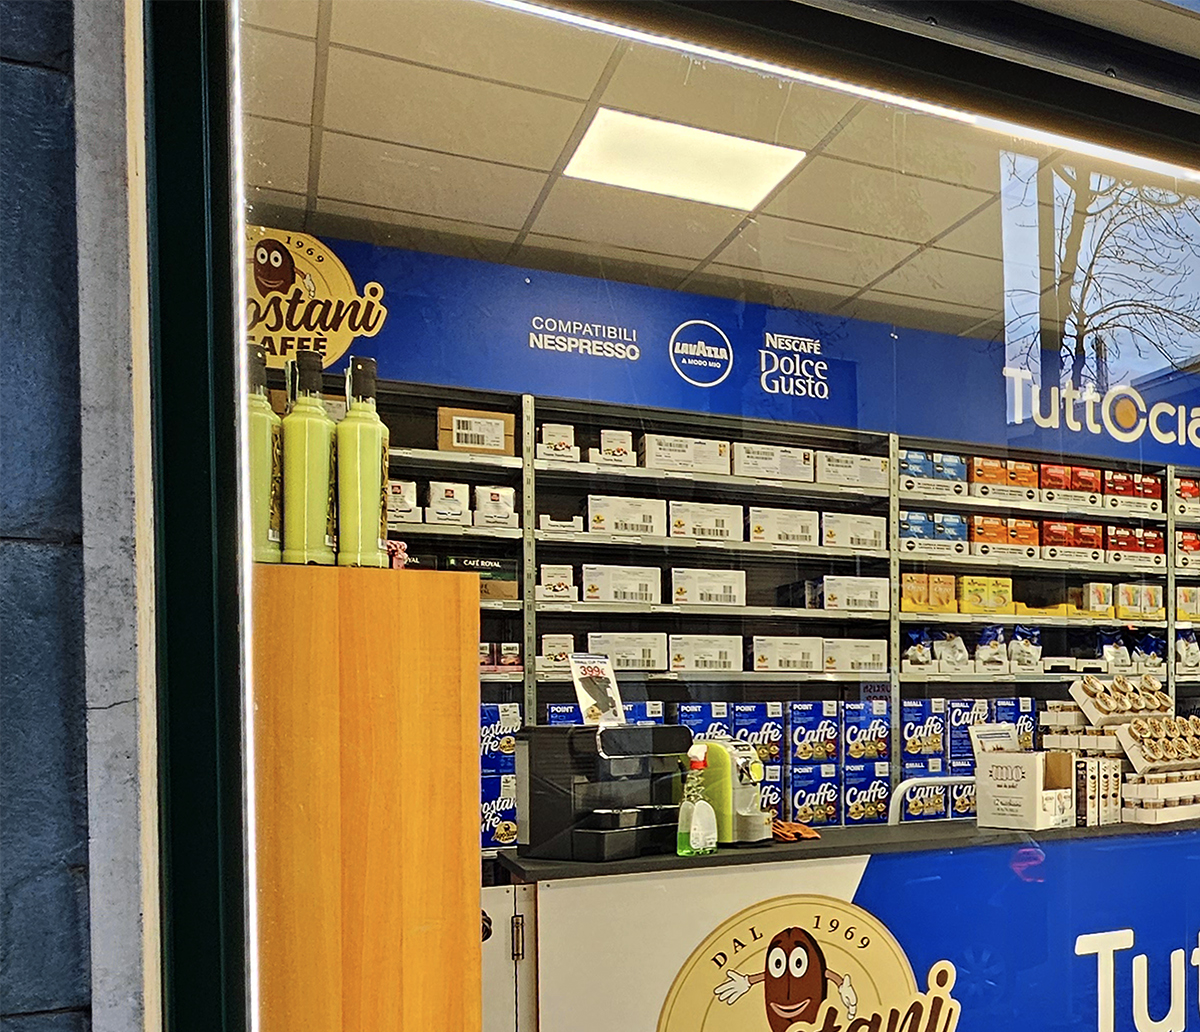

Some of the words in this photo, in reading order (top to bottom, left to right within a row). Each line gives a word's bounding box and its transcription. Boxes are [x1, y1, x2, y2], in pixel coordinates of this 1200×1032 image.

[285, 236, 325, 263] 1969
[246, 286, 383, 332] ostani
[531, 316, 637, 342] COMPATIBILI
[246, 331, 327, 357] AFFÈ
[529, 332, 641, 361] NESPRESSO
[674, 341, 729, 361] LAVAZZA
[765, 332, 821, 355] NESCAFÉ
[688, 358, 707, 367] MODO
[758, 349, 828, 380] Dolce
[760, 370, 829, 400] Gusto
[463, 558, 480, 566] CAFÉ
[481, 559, 502, 568] ROYAL
[580, 665, 606, 676] 399€
[793, 703, 813, 711] POINT
[845, 703, 865, 711] POINT
[736, 721, 783, 745] Caffè
[793, 719, 838, 746] Caffè
[846, 719, 889, 746] Caffè
[904, 716, 944, 741] Caffè
[1016, 714, 1034, 734] ffè
[793, 766, 813, 774] POINT
[760, 784, 782, 808] ffè
[793, 782, 838, 809] Caffè
[846, 780, 888, 808] Caffè
[710, 925, 764, 970] DAL
[811, 914, 872, 950] 1969
